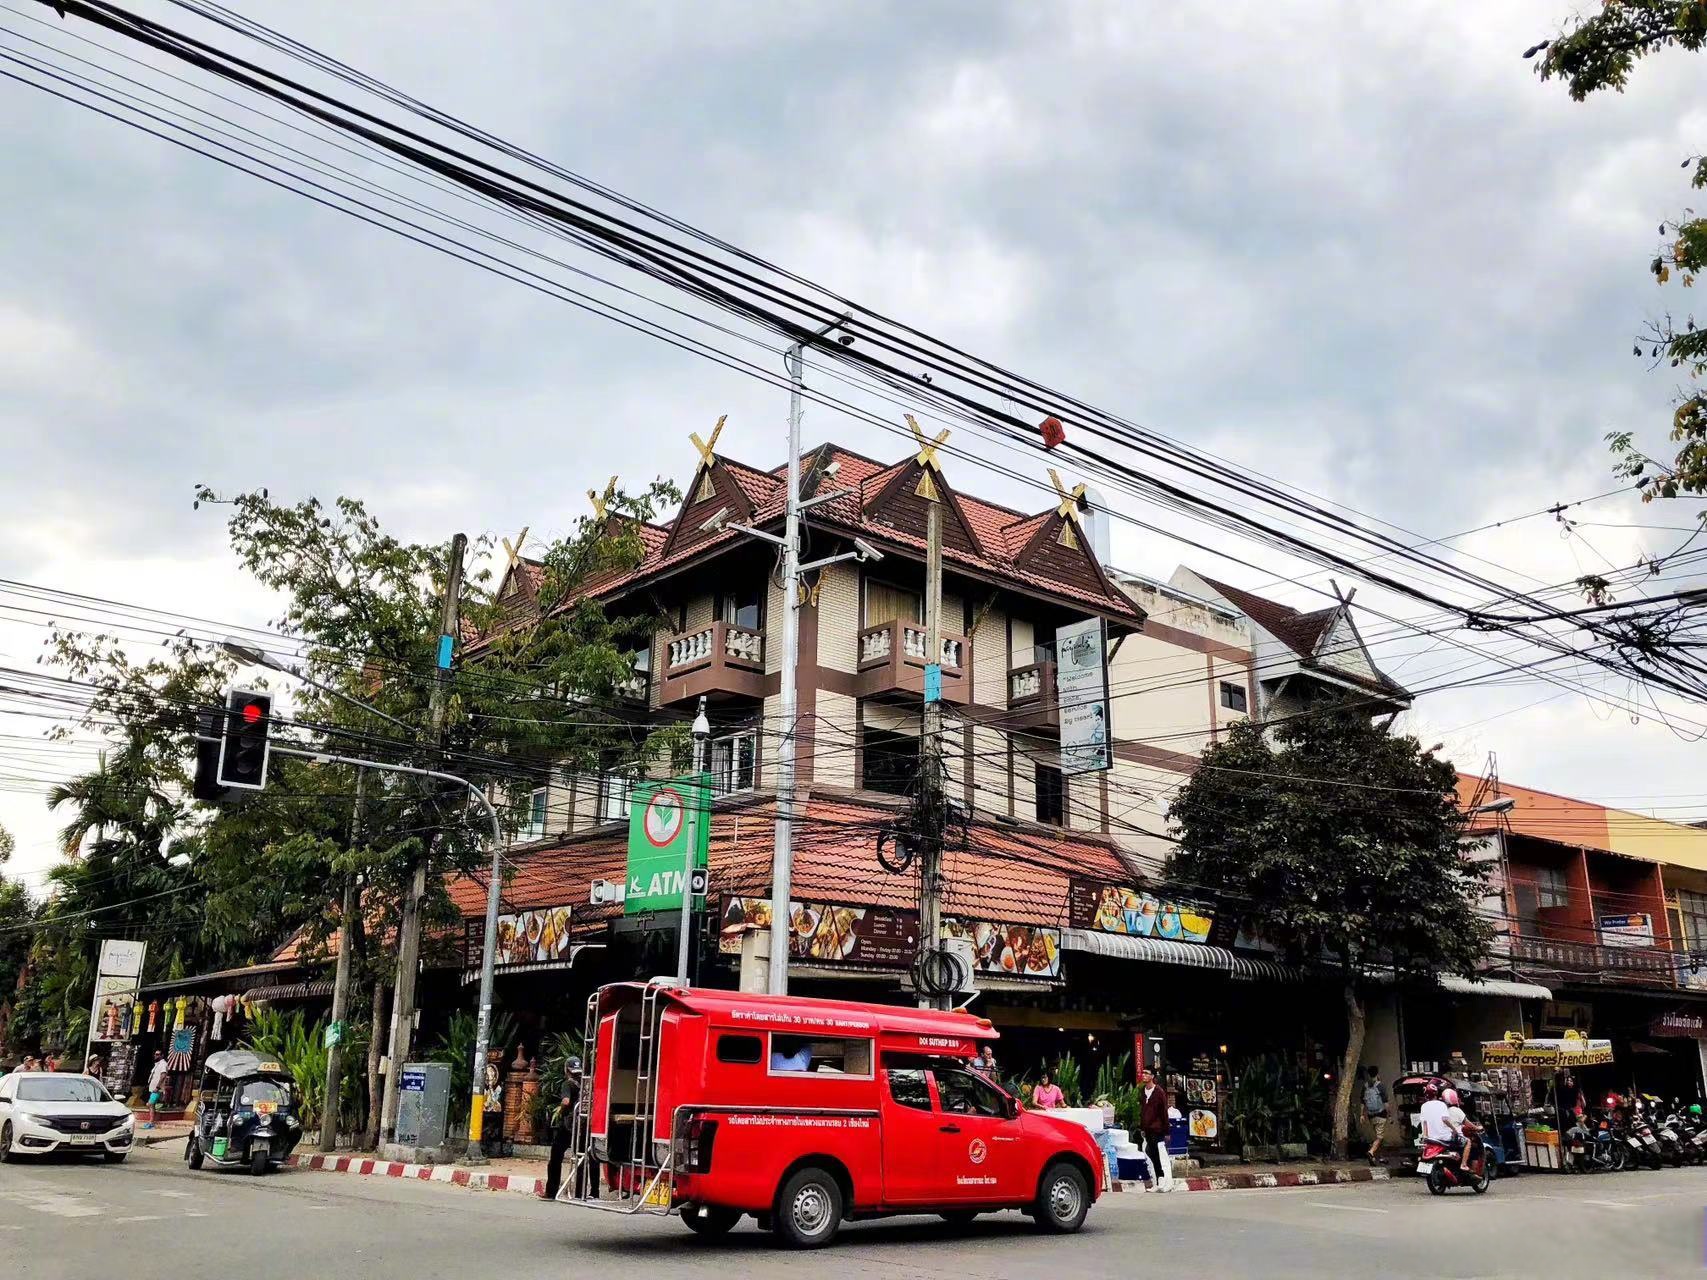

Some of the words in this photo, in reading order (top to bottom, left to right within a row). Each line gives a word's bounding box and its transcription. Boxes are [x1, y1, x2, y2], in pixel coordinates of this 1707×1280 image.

[647, 870, 686, 897] ATM
[793, 1016, 801, 1024] 30
[1484, 1051, 1520, 1065] French
[1521, 1054, 1558, 1068] crepes
[1558, 1049, 1588, 1067] French
